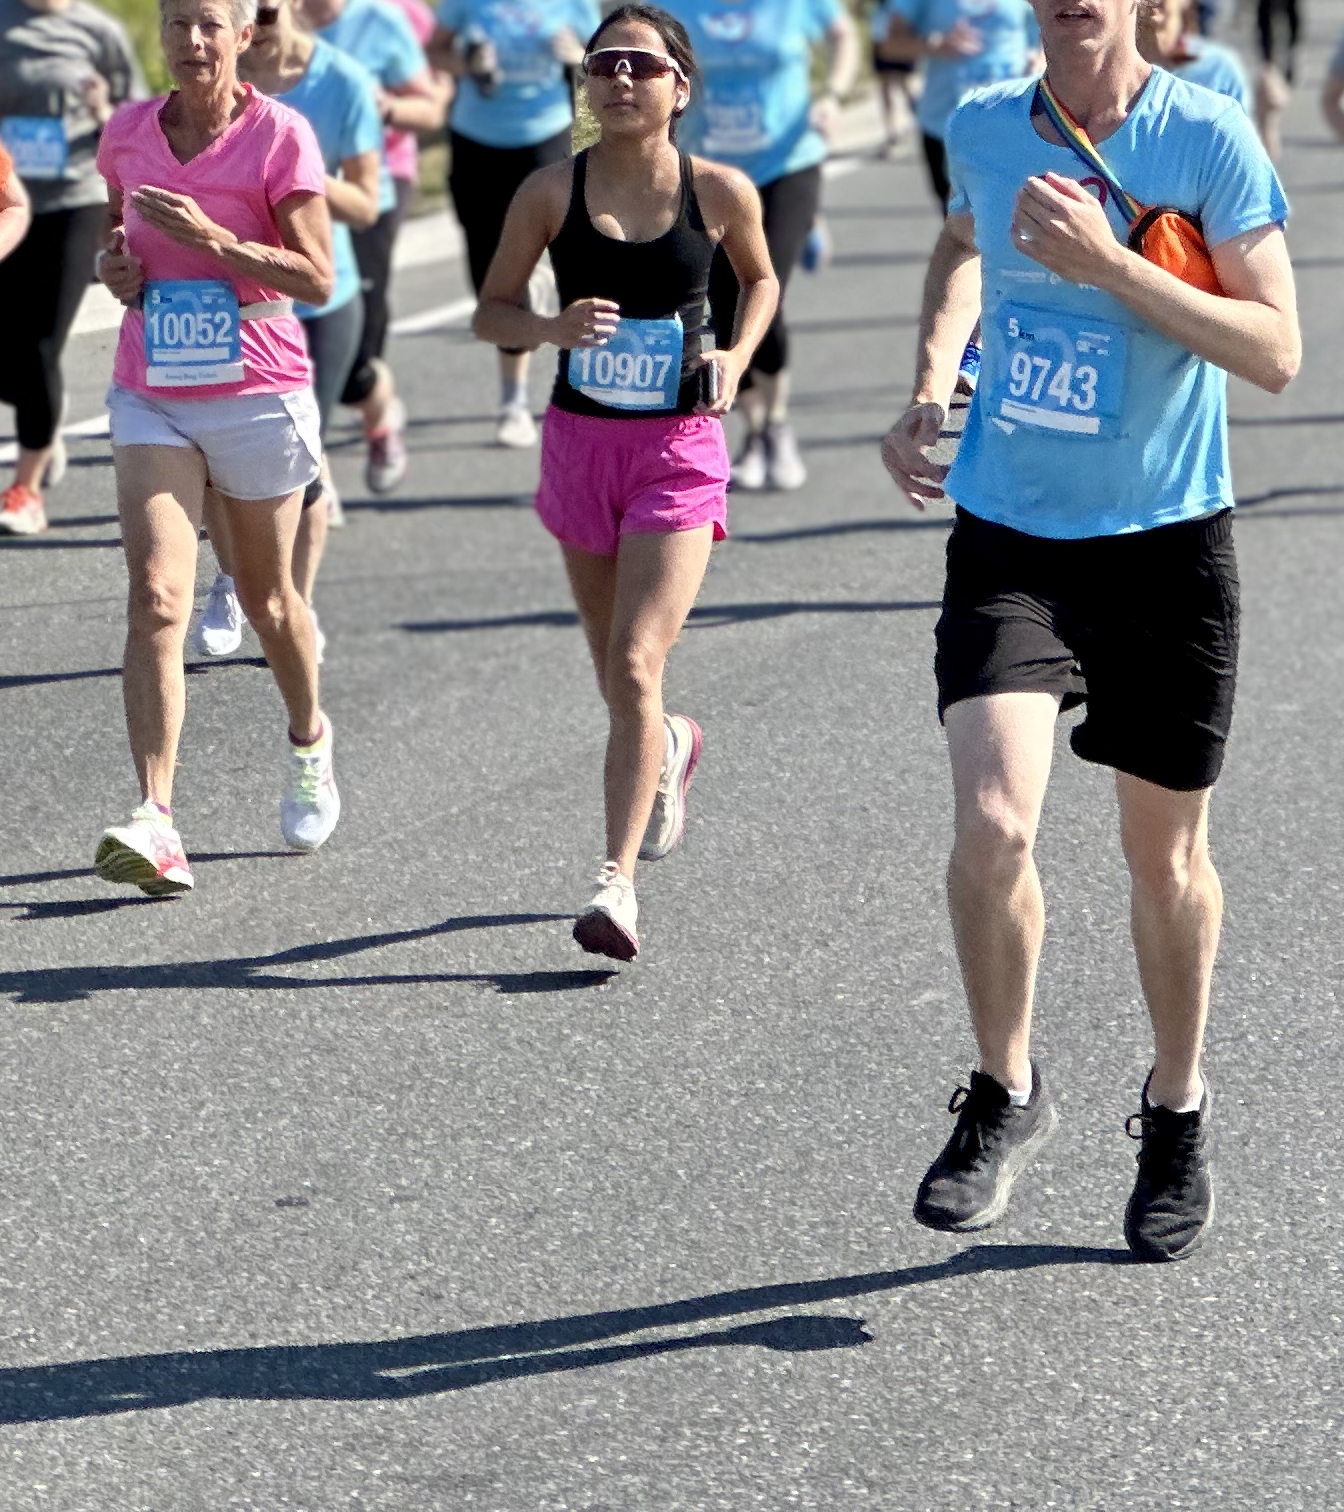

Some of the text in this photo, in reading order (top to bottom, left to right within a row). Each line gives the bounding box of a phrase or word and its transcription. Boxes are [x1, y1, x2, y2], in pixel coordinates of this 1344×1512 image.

[149, 311, 233, 346] 10052
[577, 347, 673, 388] 10907
[1008, 351, 1099, 411] 9743
